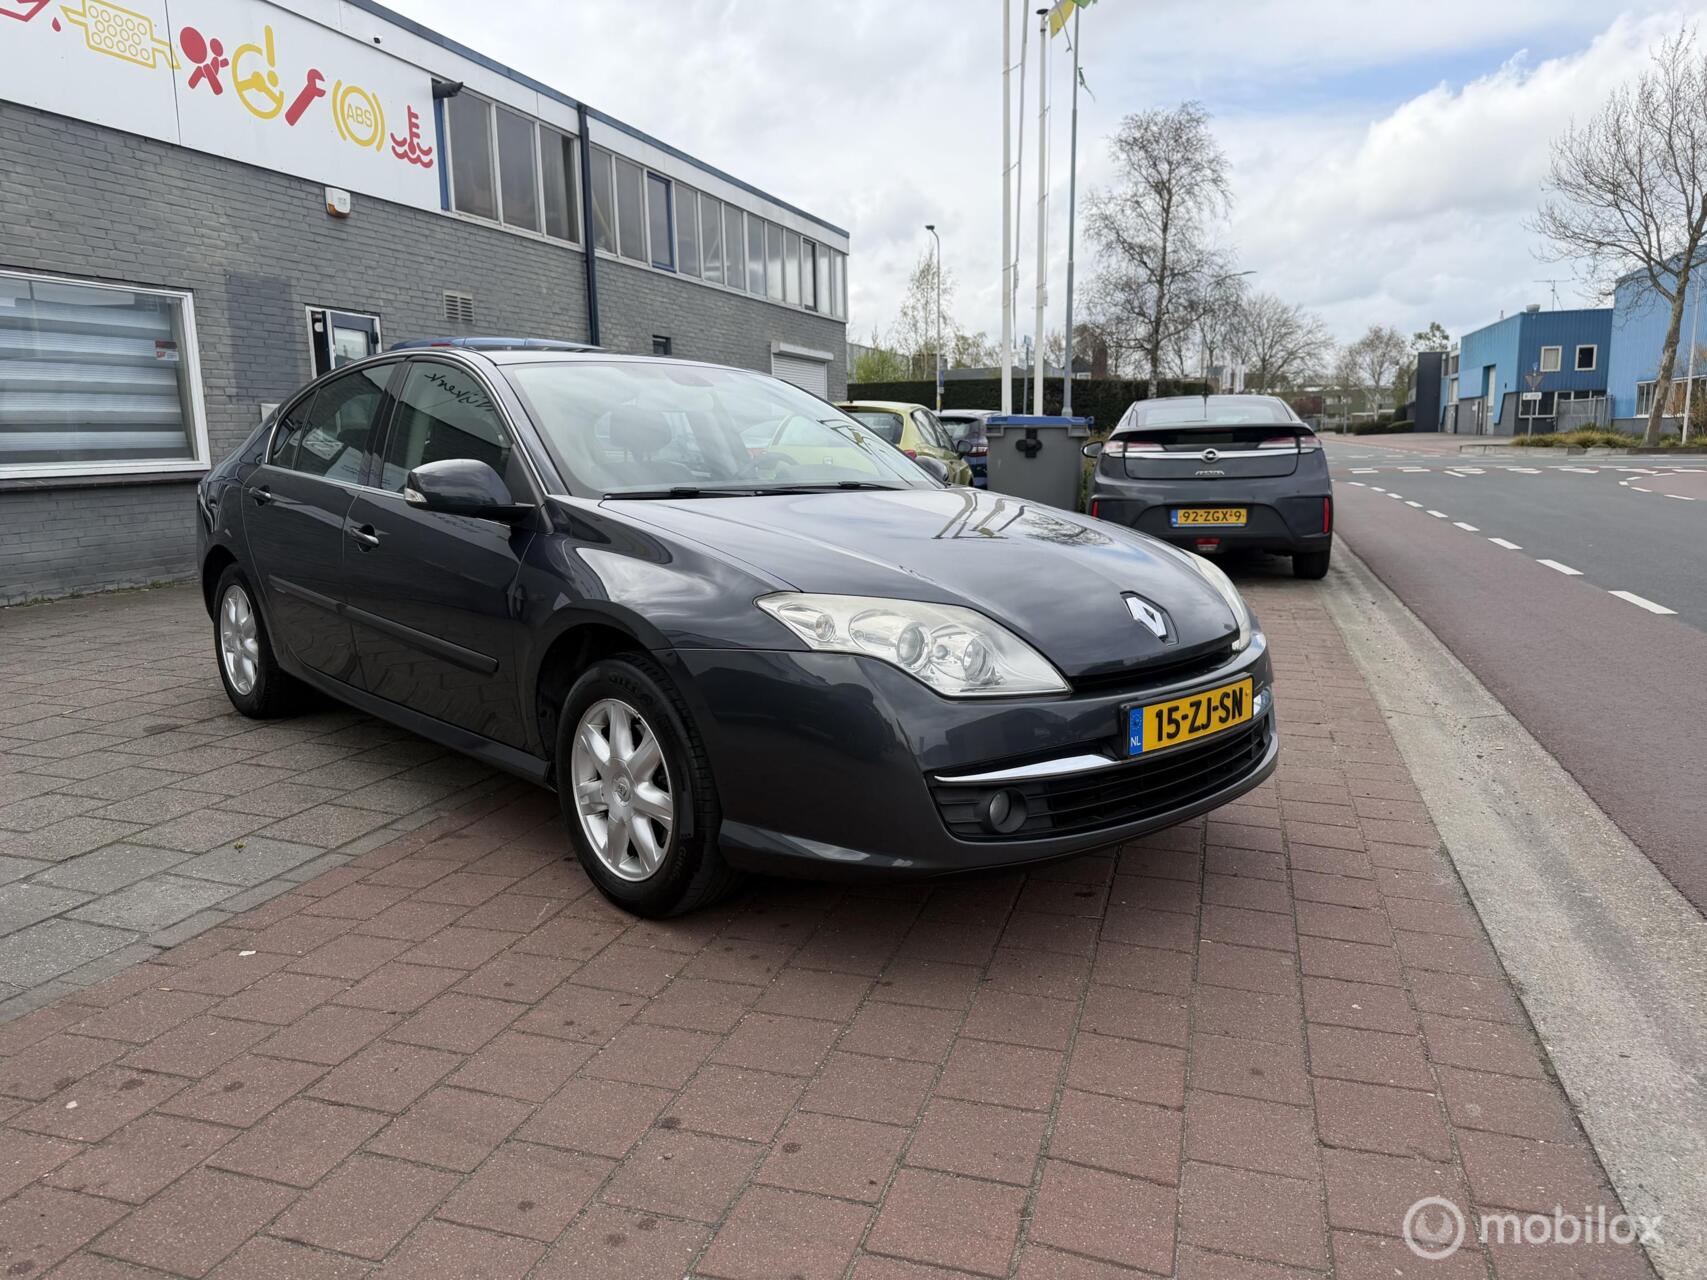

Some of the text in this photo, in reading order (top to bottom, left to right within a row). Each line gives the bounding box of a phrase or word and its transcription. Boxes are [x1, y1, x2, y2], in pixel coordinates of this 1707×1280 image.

[347, 103, 373, 128] ABS
[1182, 510, 1242, 522] 92-ZGX-9
[1155, 687, 1244, 742] 15-ZJ-SN
[1130, 736, 1142, 747] NL
